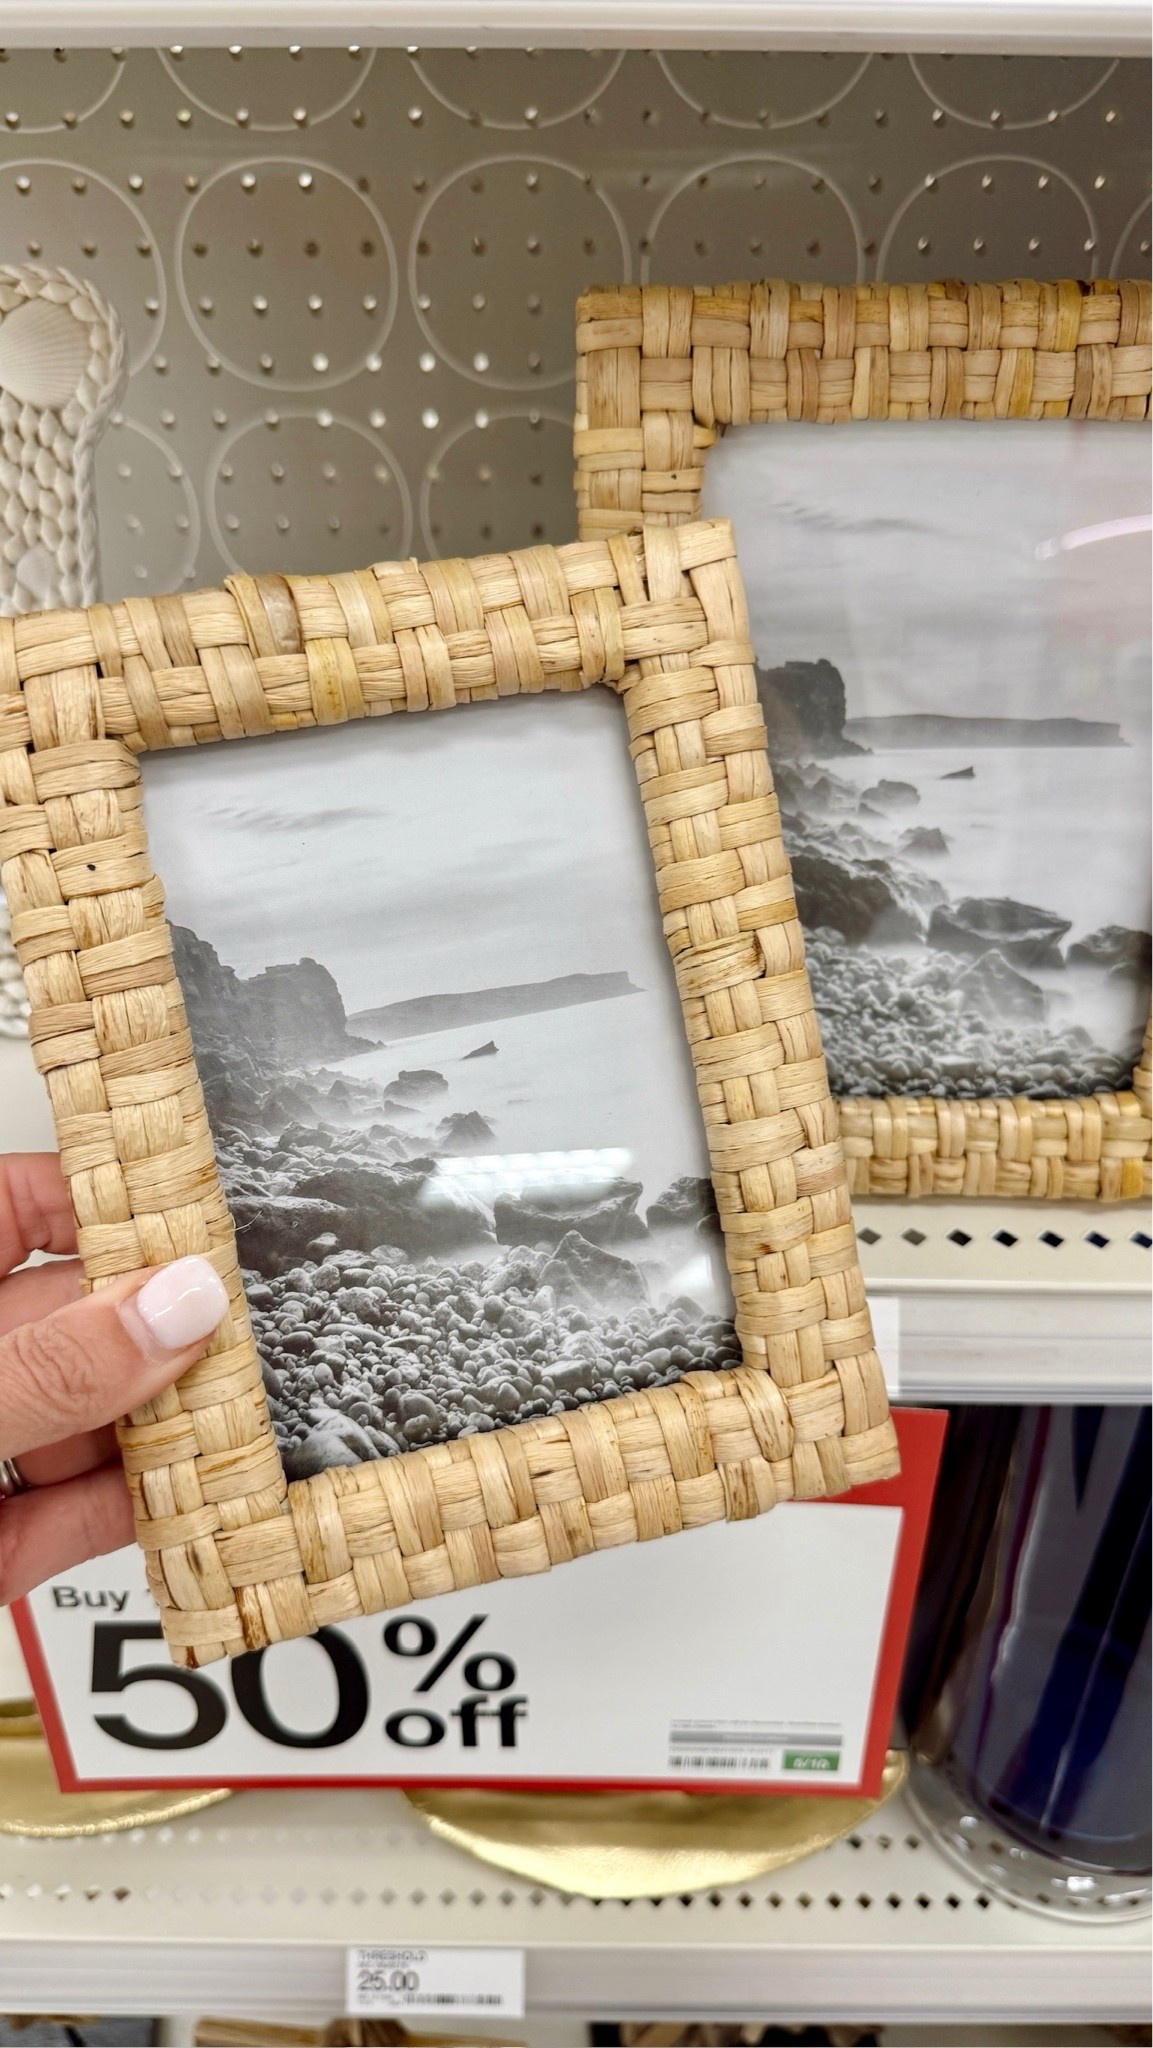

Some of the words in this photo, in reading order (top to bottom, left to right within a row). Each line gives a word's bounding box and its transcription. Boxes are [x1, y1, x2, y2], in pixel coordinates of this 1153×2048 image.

[52, 1585, 130, 1612] Buy
[384, 1695, 528, 1748] off
[357, 1969, 420, 1991] 25.00
